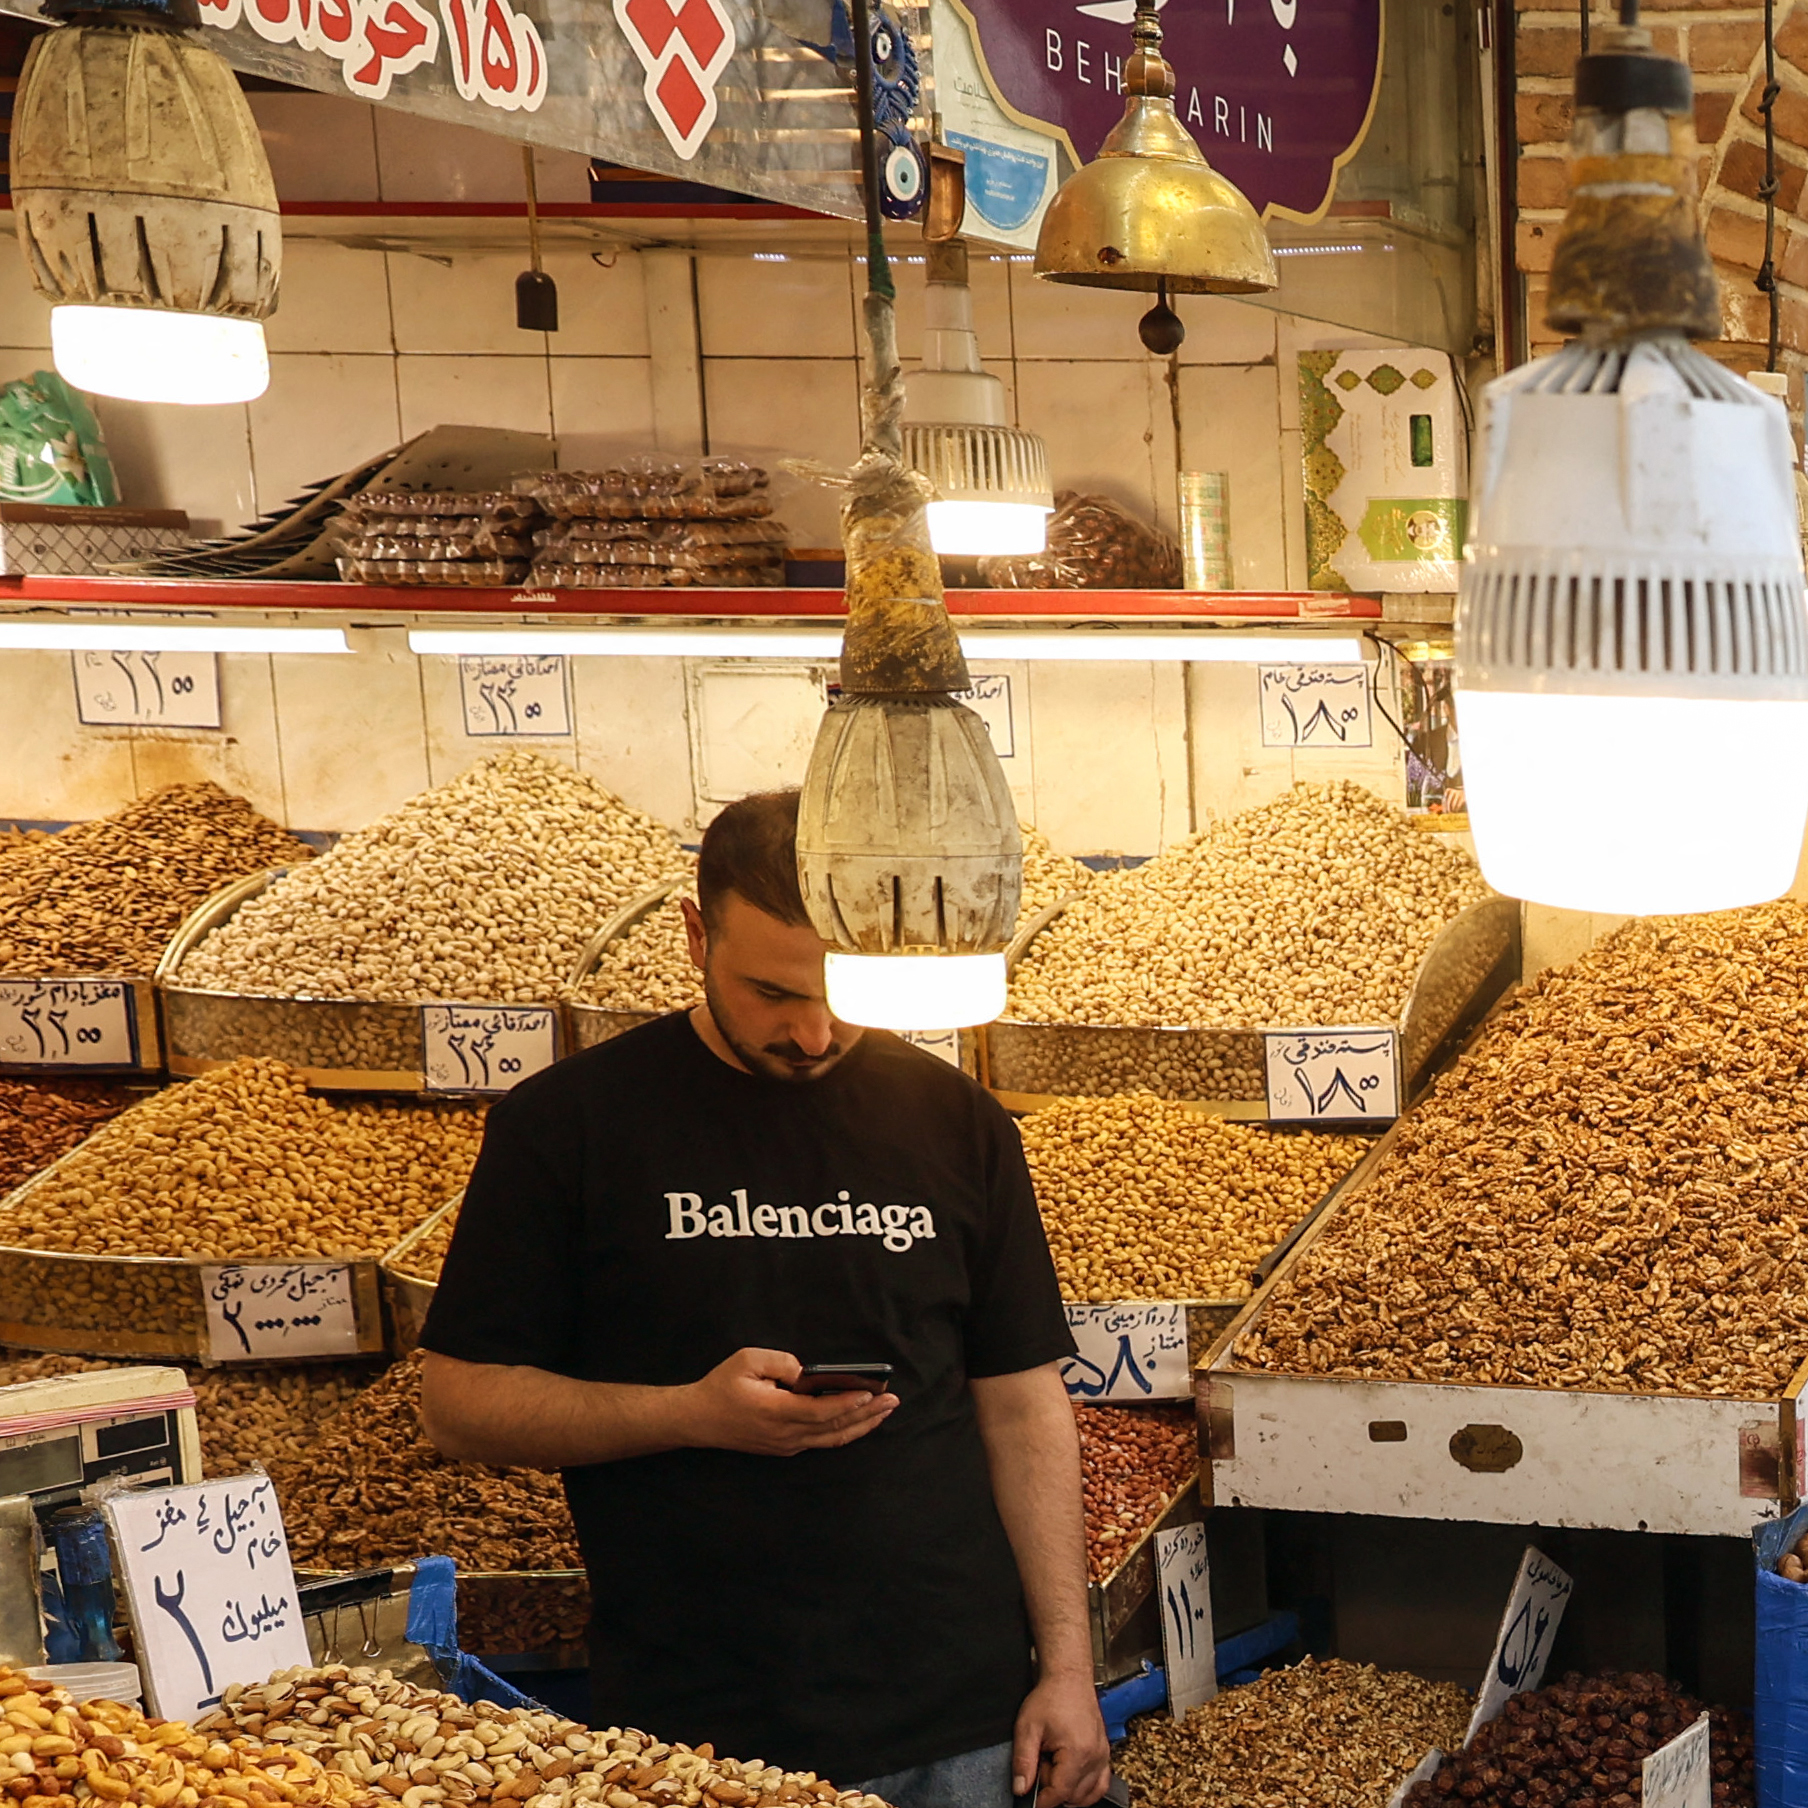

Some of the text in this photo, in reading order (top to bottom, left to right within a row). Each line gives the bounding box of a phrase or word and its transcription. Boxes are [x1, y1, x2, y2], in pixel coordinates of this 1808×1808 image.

[1283, 1037, 1337, 1066] فندقی
[1335, 1039, 1391, 1058] پسته
[664, 1189, 936, 1252] Balenciaga
[140, 1498, 187, 1552] مغز
[213, 1479, 271, 1555] آجیل
[222, 1593, 289, 1643] میلیون
